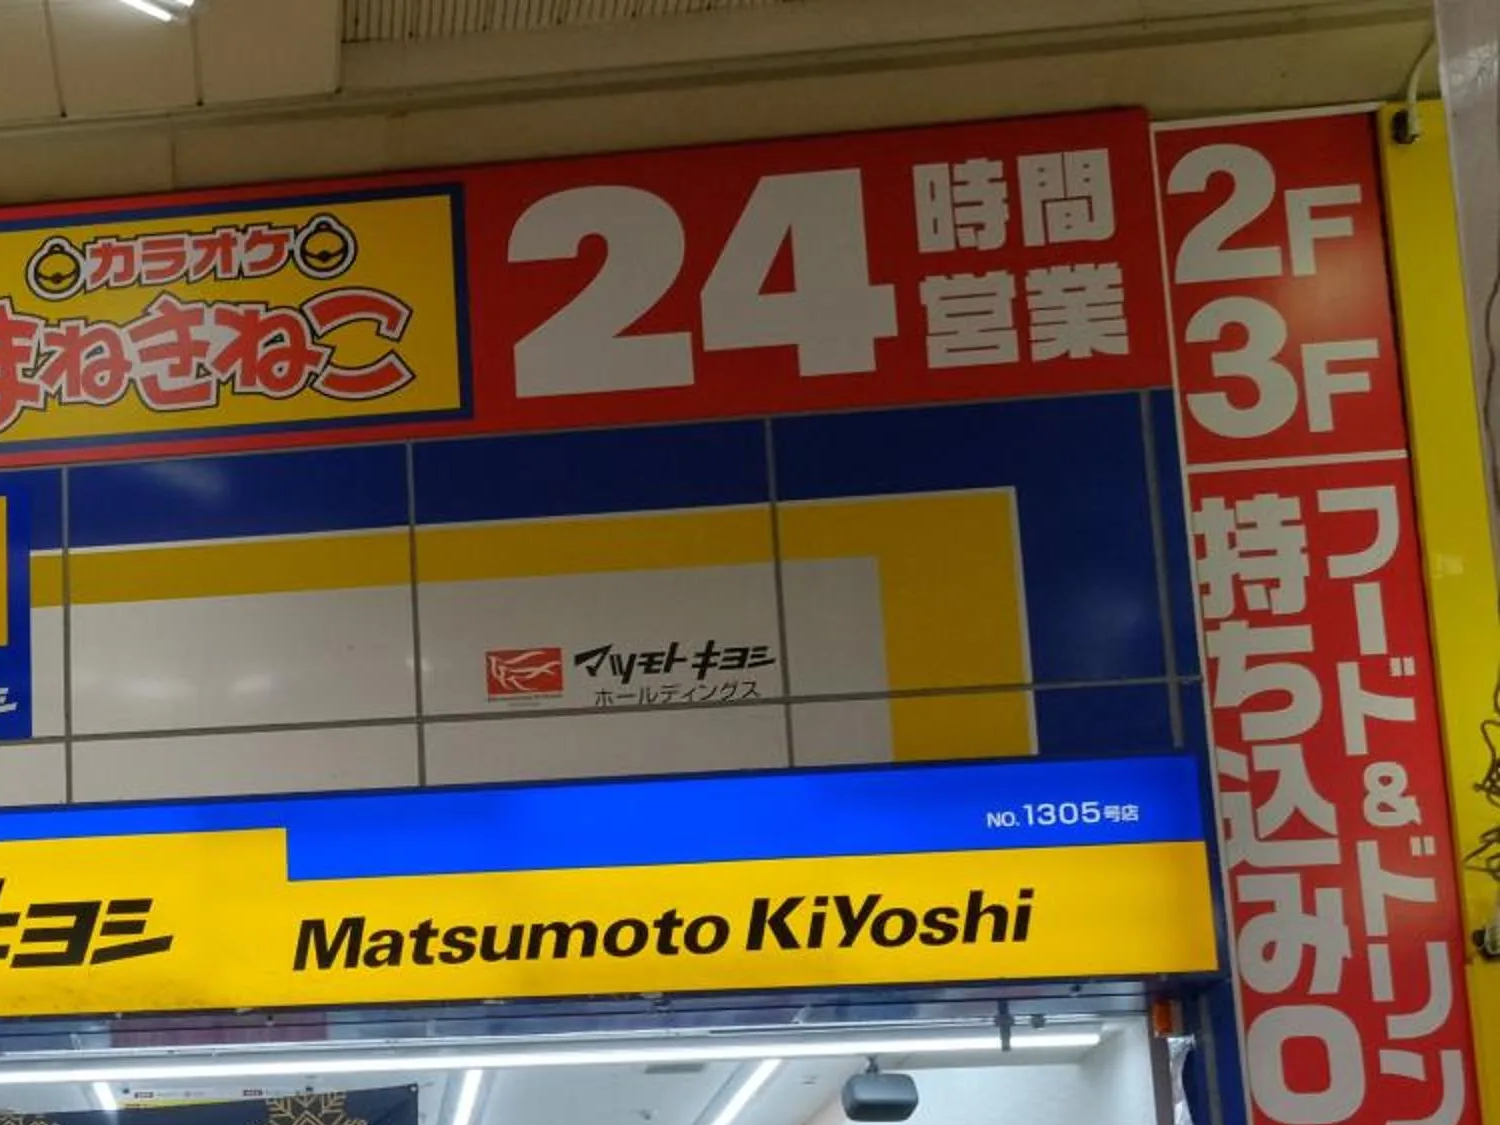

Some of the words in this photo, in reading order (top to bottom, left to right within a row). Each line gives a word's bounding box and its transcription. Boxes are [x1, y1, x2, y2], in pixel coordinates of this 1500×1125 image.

[912, 148, 1116, 253] 時間
[1166, 143, 1362, 284] 2F
[81, 224, 301, 291] カラオケ
[508, 168, 898, 398] 24
[919, 262, 1131, 369] 営業
[1184, 296, 1380, 438] 3F
[573, 639, 776, 685] マツモトキヨシ
[594, 680, 763, 706] ホールディングス
[292, 904, 730, 971] Matsumoto
[745, 888, 1034, 951] KiYoshi
